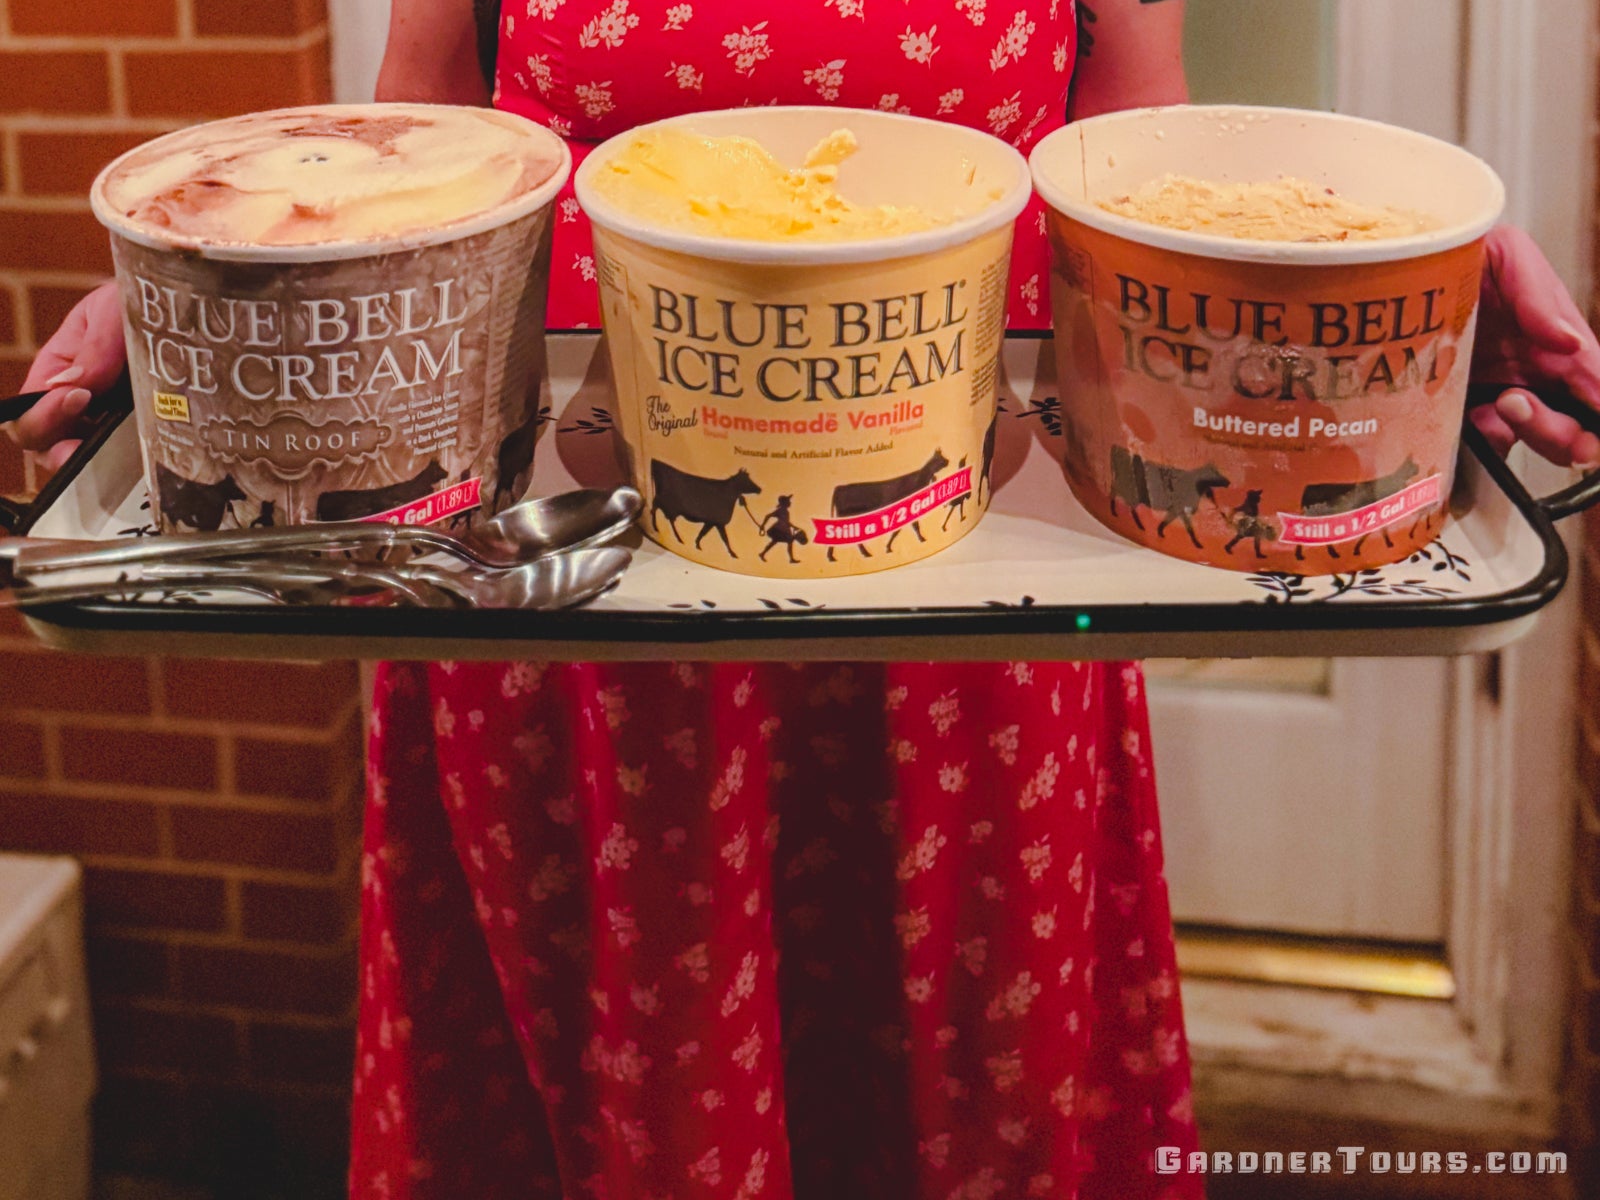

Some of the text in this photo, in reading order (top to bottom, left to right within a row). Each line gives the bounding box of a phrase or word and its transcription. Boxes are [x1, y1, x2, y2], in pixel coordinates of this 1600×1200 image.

[136, 276, 281, 348] BLUE
[304, 279, 468, 348] BELL
[648, 282, 811, 349] BLUE
[829, 280, 968, 348] BELL
[1115, 273, 1289, 346] BLUE
[1308, 289, 1445, 348] BELL
[142, 329, 218, 394] ICE
[231, 328, 465, 402] CREAM
[653, 336, 744, 399] ICE
[756, 329, 968, 402] CREAM
[1119, 325, 1438, 401] ICE CREAM
[646, 395, 671, 414] The
[648, 407, 698, 437] Original
[702, 400, 924, 434] Homemade Vanilla
[1193, 406, 1378, 438] Buttered Pecan
[223, 429, 361, 452] TIN ROOF
[734, 440, 894, 459] Natural and Artificial Flavor Added
[404, 500, 433, 524] Gal
[824, 520, 861, 539] Still
[864, 522, 877, 534] a
[881, 507, 907, 529] 1/2
[910, 491, 935, 514] Gal
[1294, 522, 1330, 538] Still
[1334, 524, 1346, 536] a
[1352, 511, 1377, 531] 1/2
[1380, 496, 1404, 520] Gal
